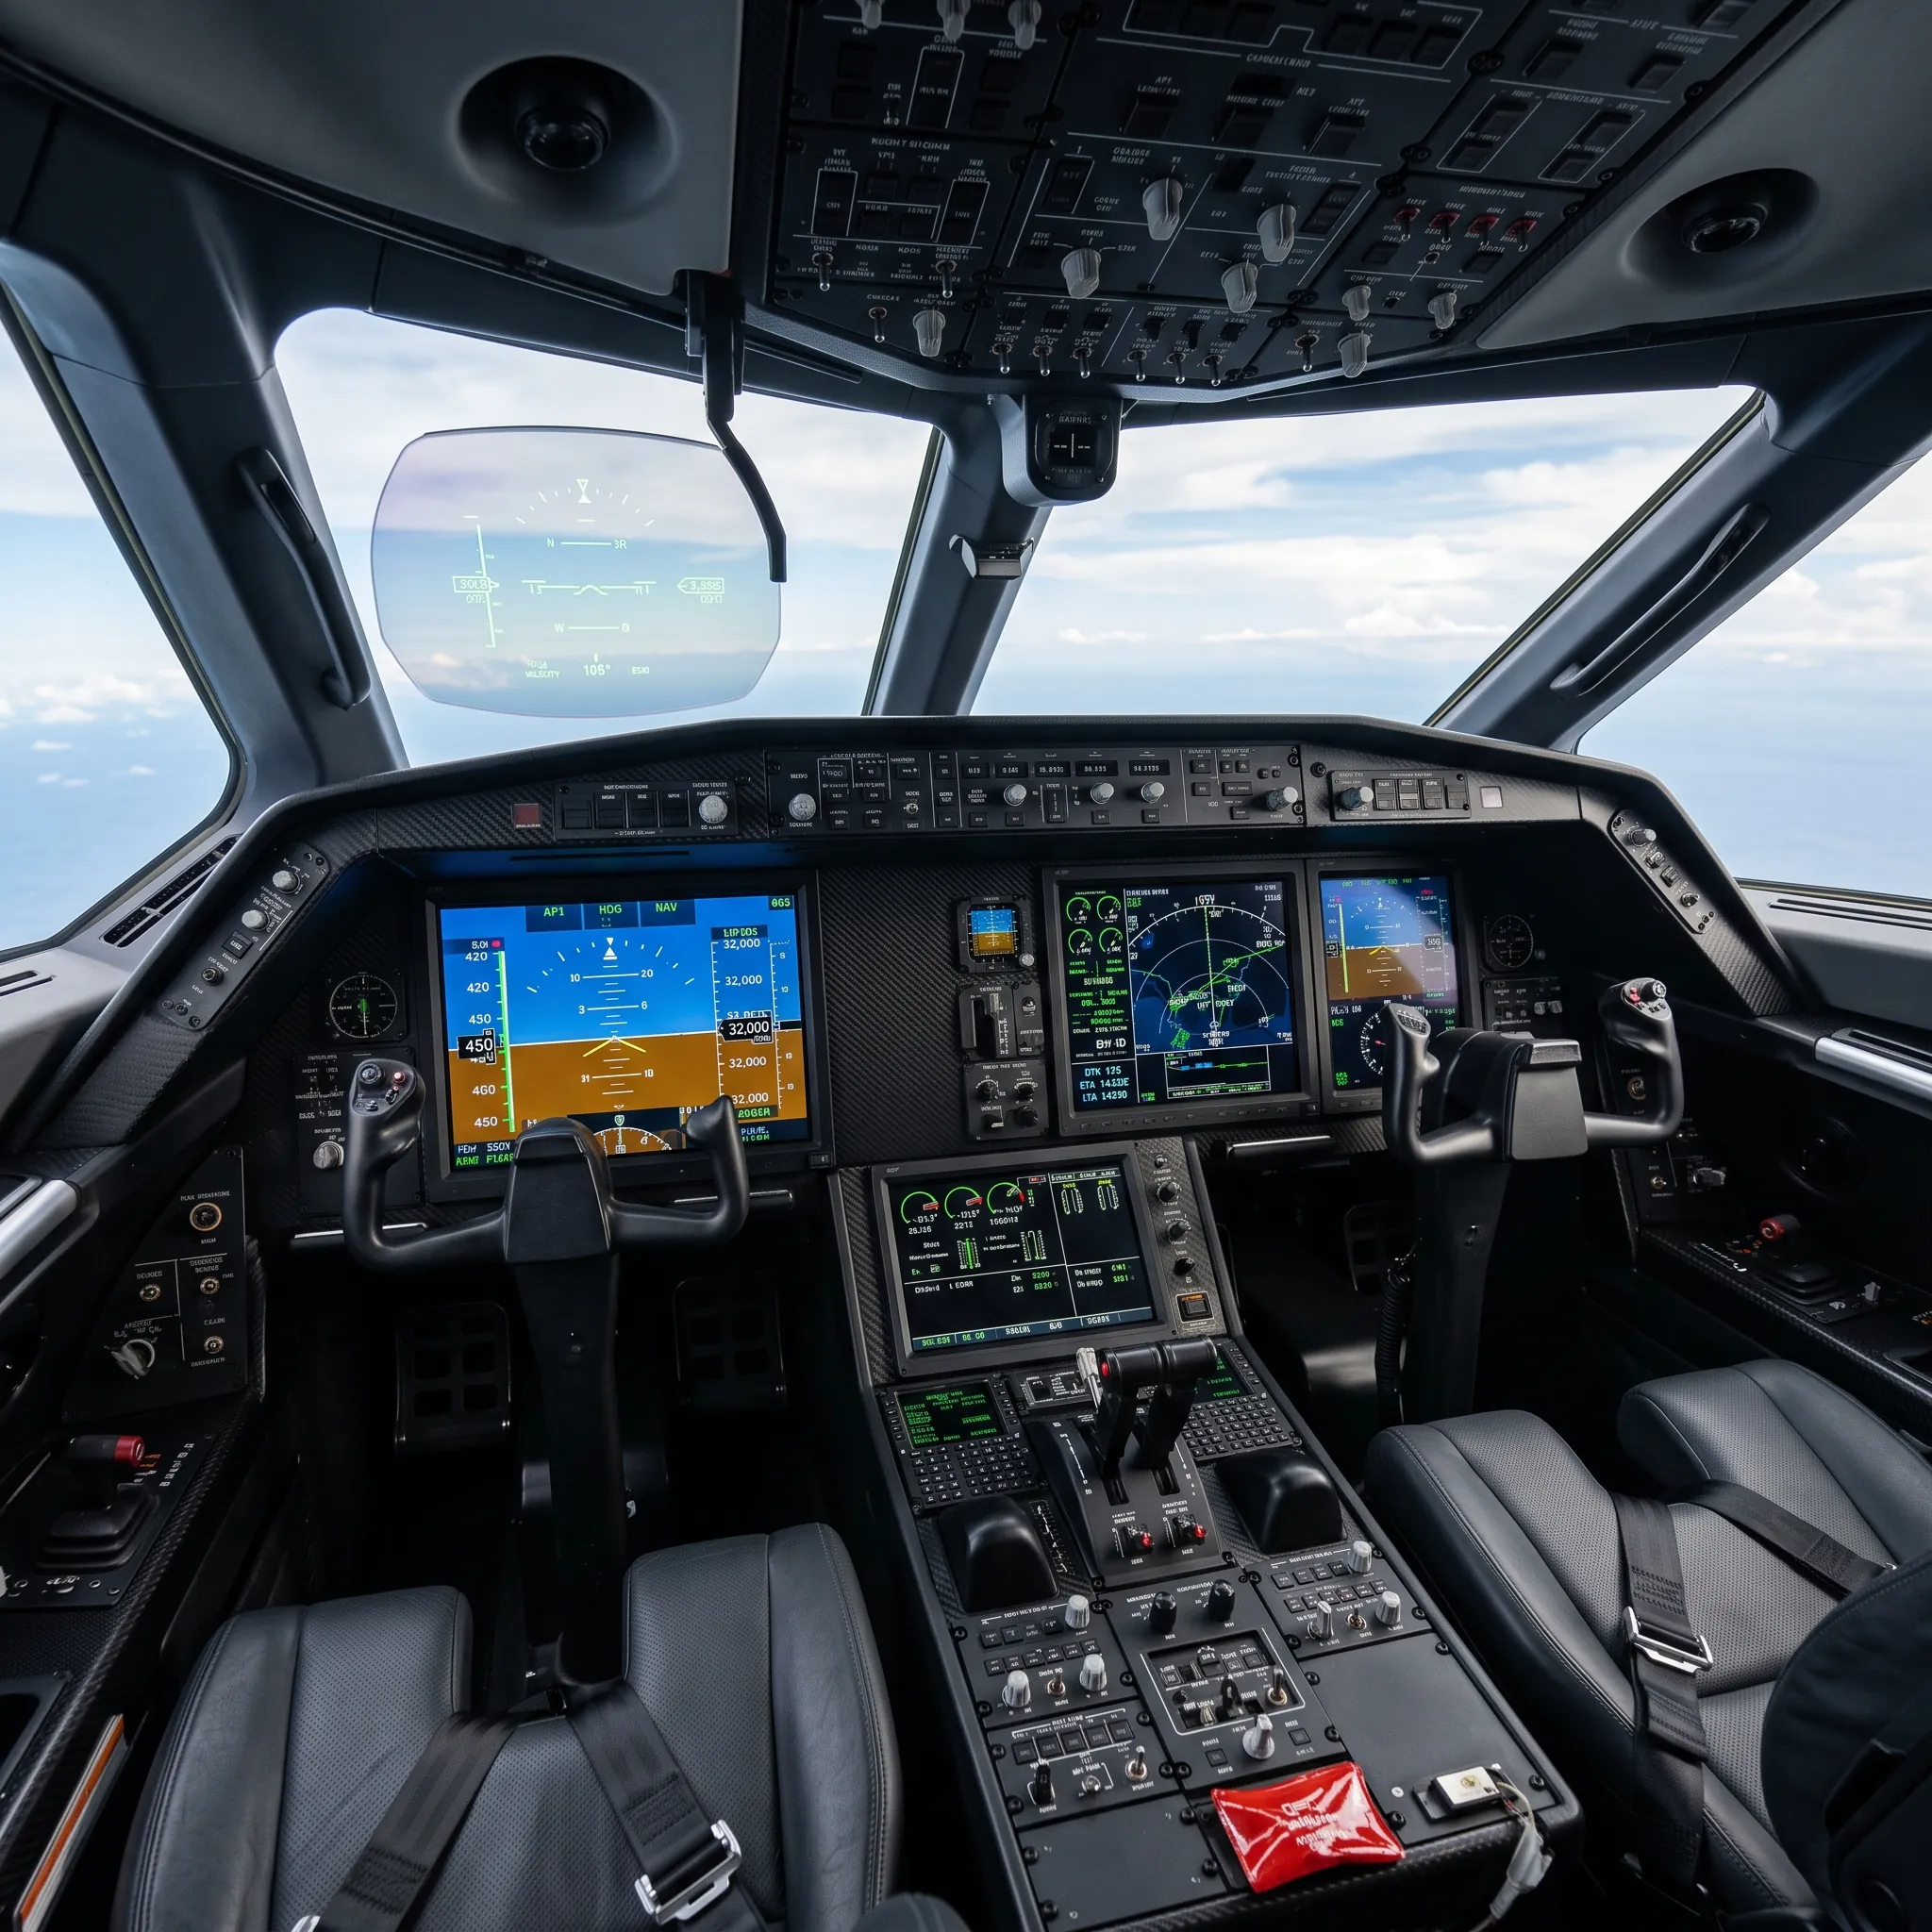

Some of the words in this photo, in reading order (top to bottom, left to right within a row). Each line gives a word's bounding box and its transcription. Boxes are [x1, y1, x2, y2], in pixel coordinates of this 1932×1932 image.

[546, 538, 555, 548] N
[554, 623, 564, 633] W
[543, 907, 565, 917] AP1
[656, 902, 678, 913] NAV
[723, 938, 761, 951] 32,000
[465, 952, 489, 962] 420
[641, 969, 654, 978] 20
[724, 974, 763, 987] 32,000
[466, 982, 490, 993] 420
[578, 1005, 586, 1015] 3
[641, 1001, 648, 1010] 6
[728, 1021, 770, 1036] 32,000
[465, 1038, 493, 1053] 450
[728, 1056, 767, 1069] 32,000
[1084, 1068, 1102, 1077] DTK
[472, 1084, 496, 1096] 460
[1079, 1081, 1096, 1090] ETA
[474, 1116, 498, 1128] 450
